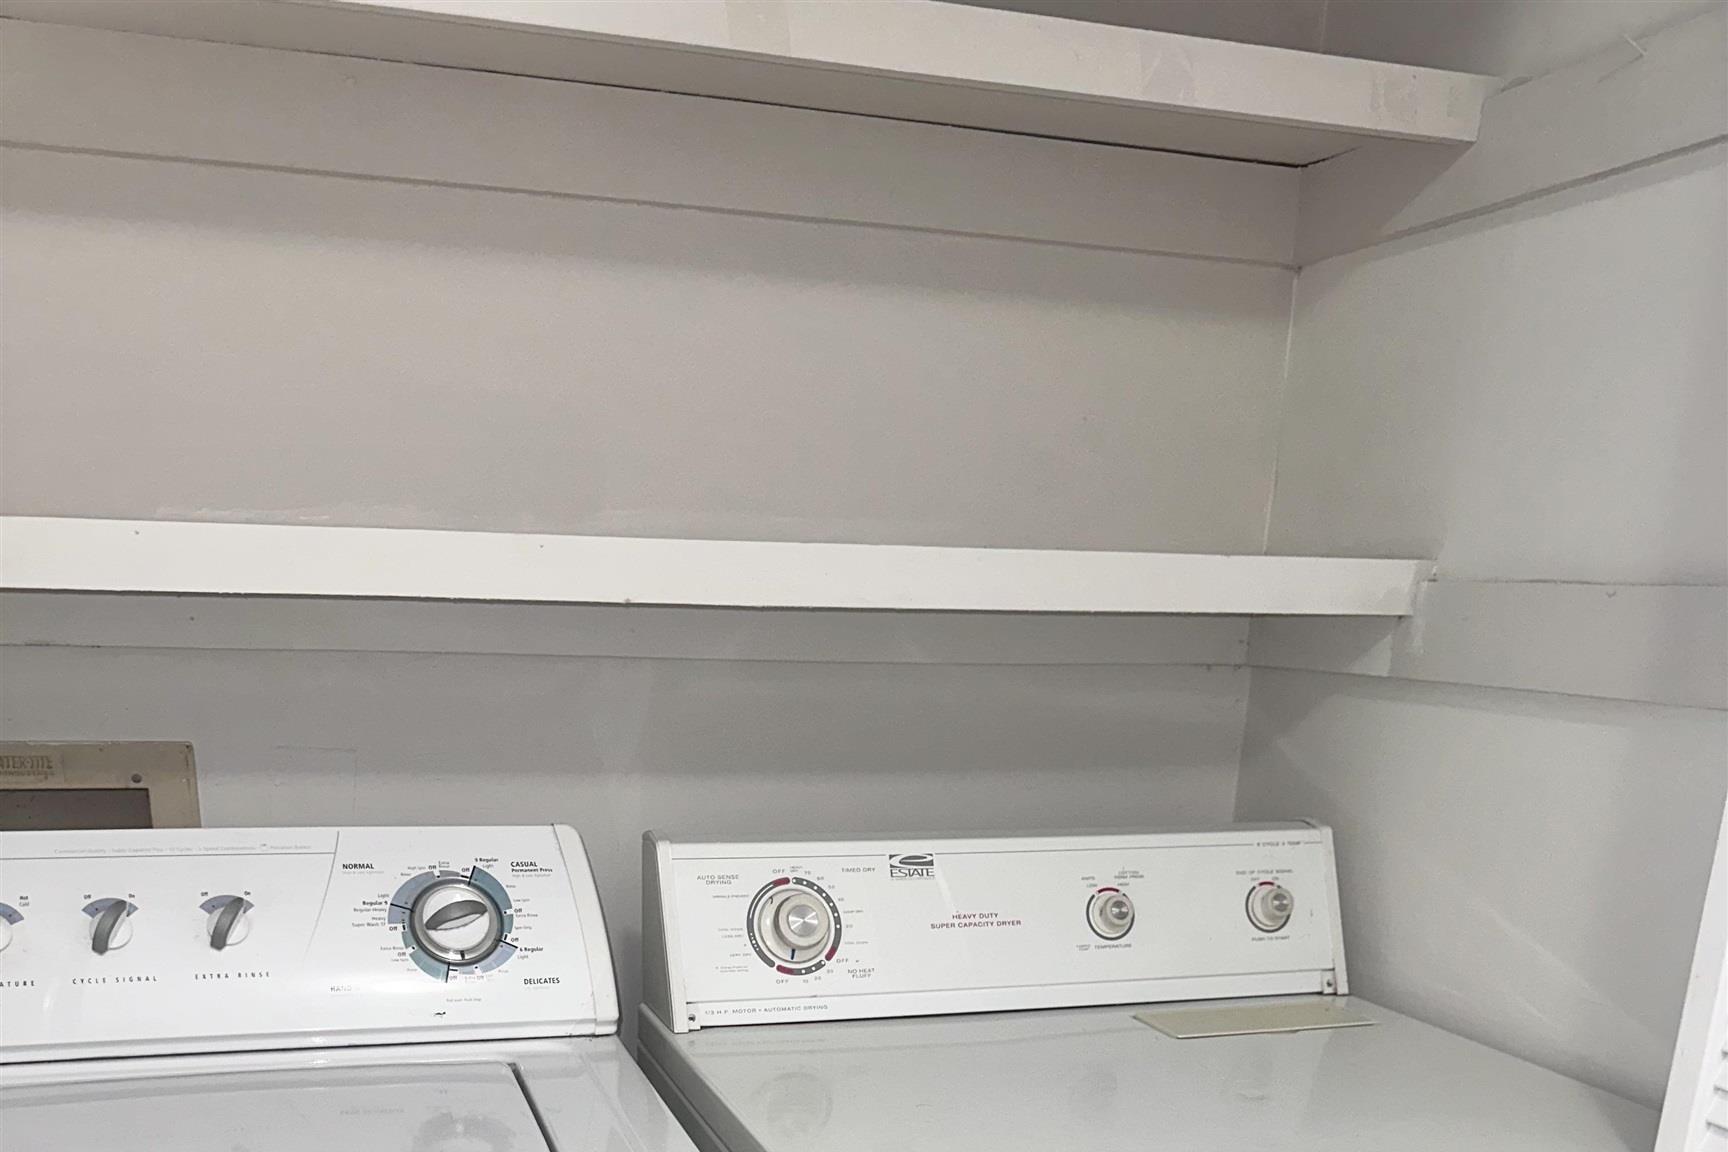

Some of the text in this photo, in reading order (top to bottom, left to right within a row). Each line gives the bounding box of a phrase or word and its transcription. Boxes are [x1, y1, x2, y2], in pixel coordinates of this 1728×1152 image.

[889, 868, 935, 878] ESTATE
[957, 921, 995, 929] CAPACITY
[996, 919, 1022, 927] DRYER
[72, 977, 106, 985] CYCLE
[523, 977, 560, 985] DELICATES
[763, 1005, 801, 1013] AUTOMATIC
[802, 1003, 829, 1011] DRYING
